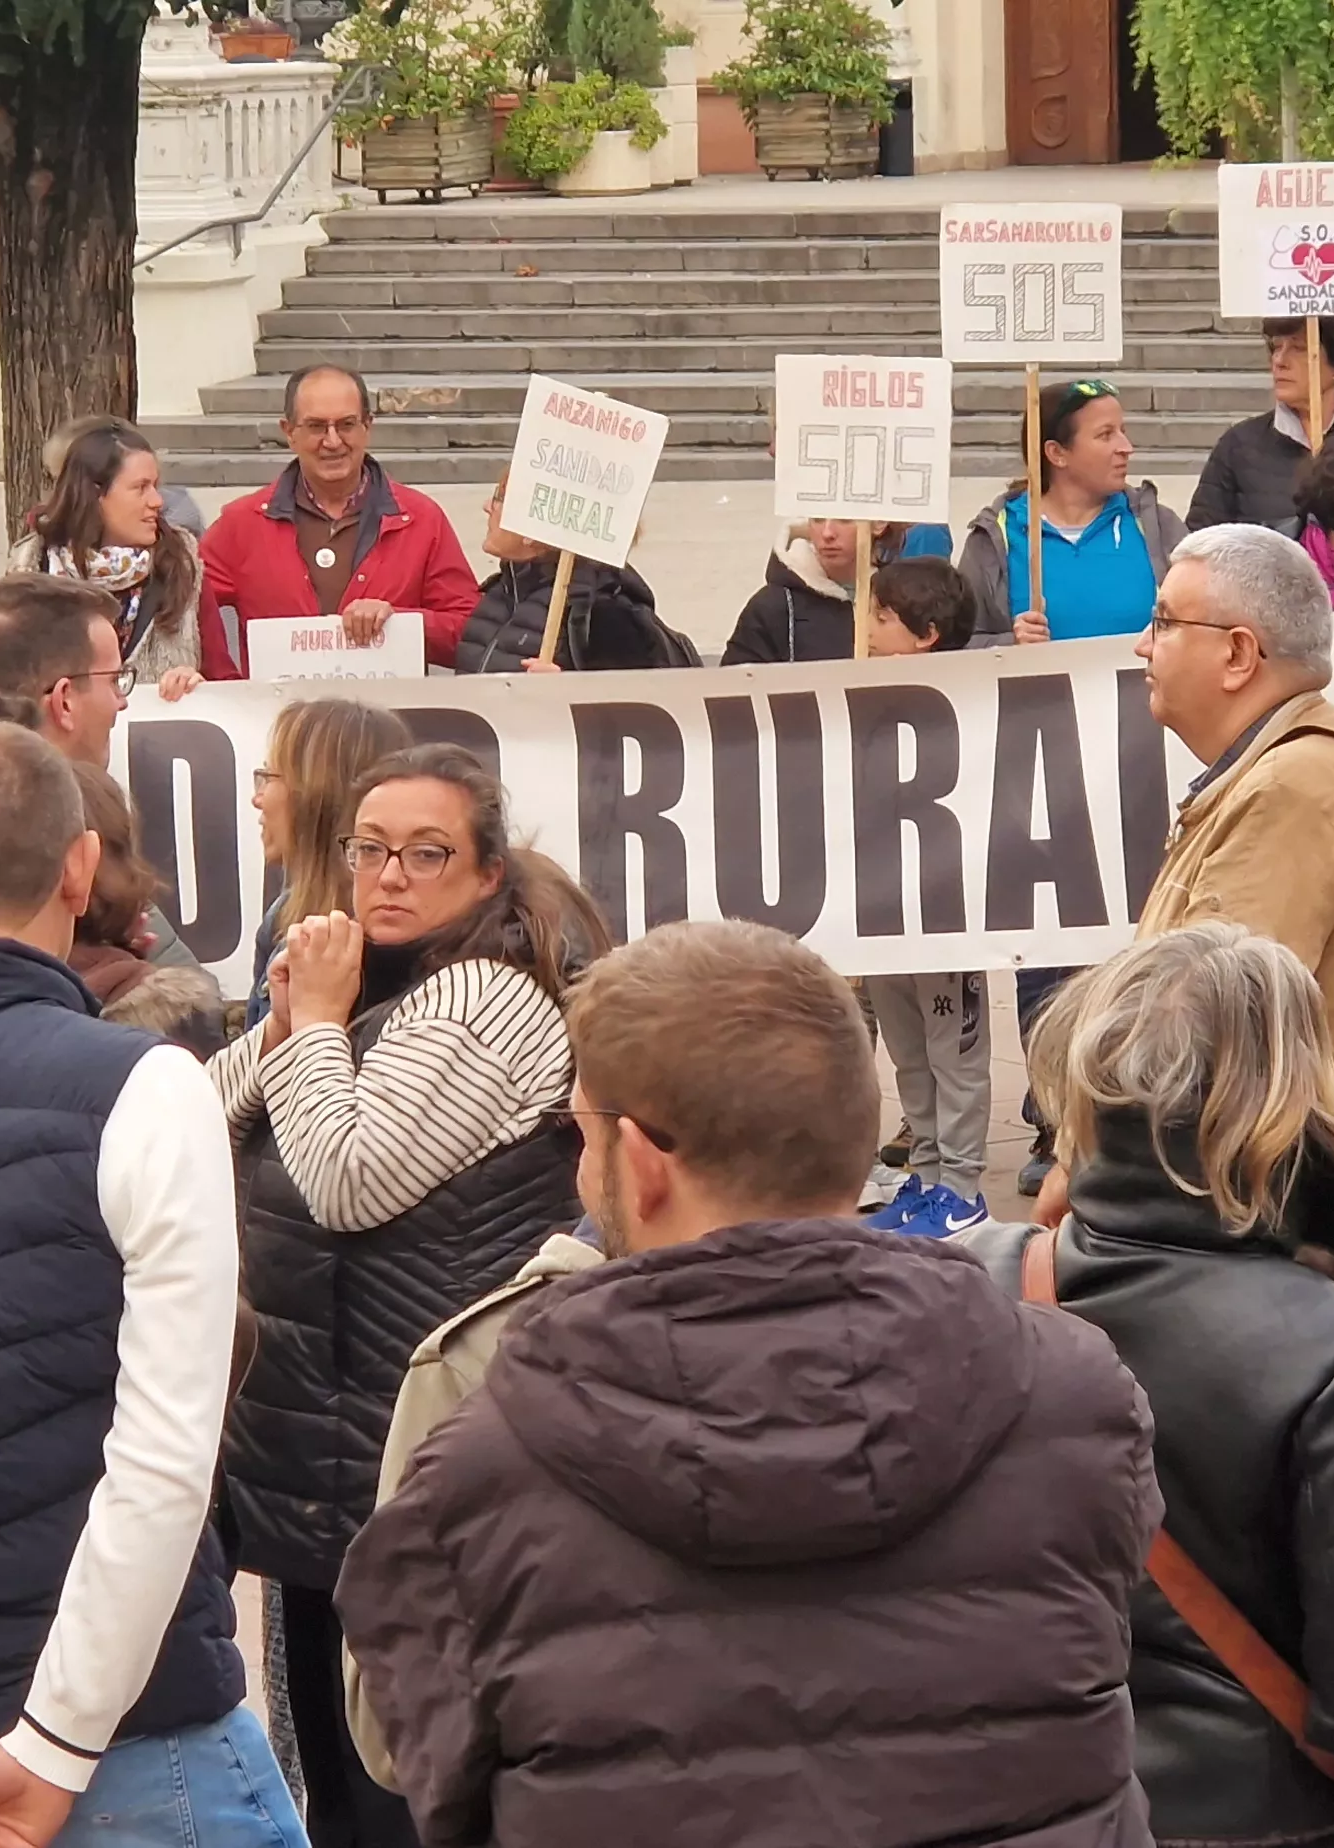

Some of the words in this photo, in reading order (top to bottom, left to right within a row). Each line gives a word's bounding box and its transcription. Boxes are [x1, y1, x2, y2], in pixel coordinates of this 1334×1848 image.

[964, 263, 1105, 342] SOS
[530, 438, 635, 495] SANIDAD
[797, 425, 935, 507] SOS
[528, 482, 616, 543] RURAL
